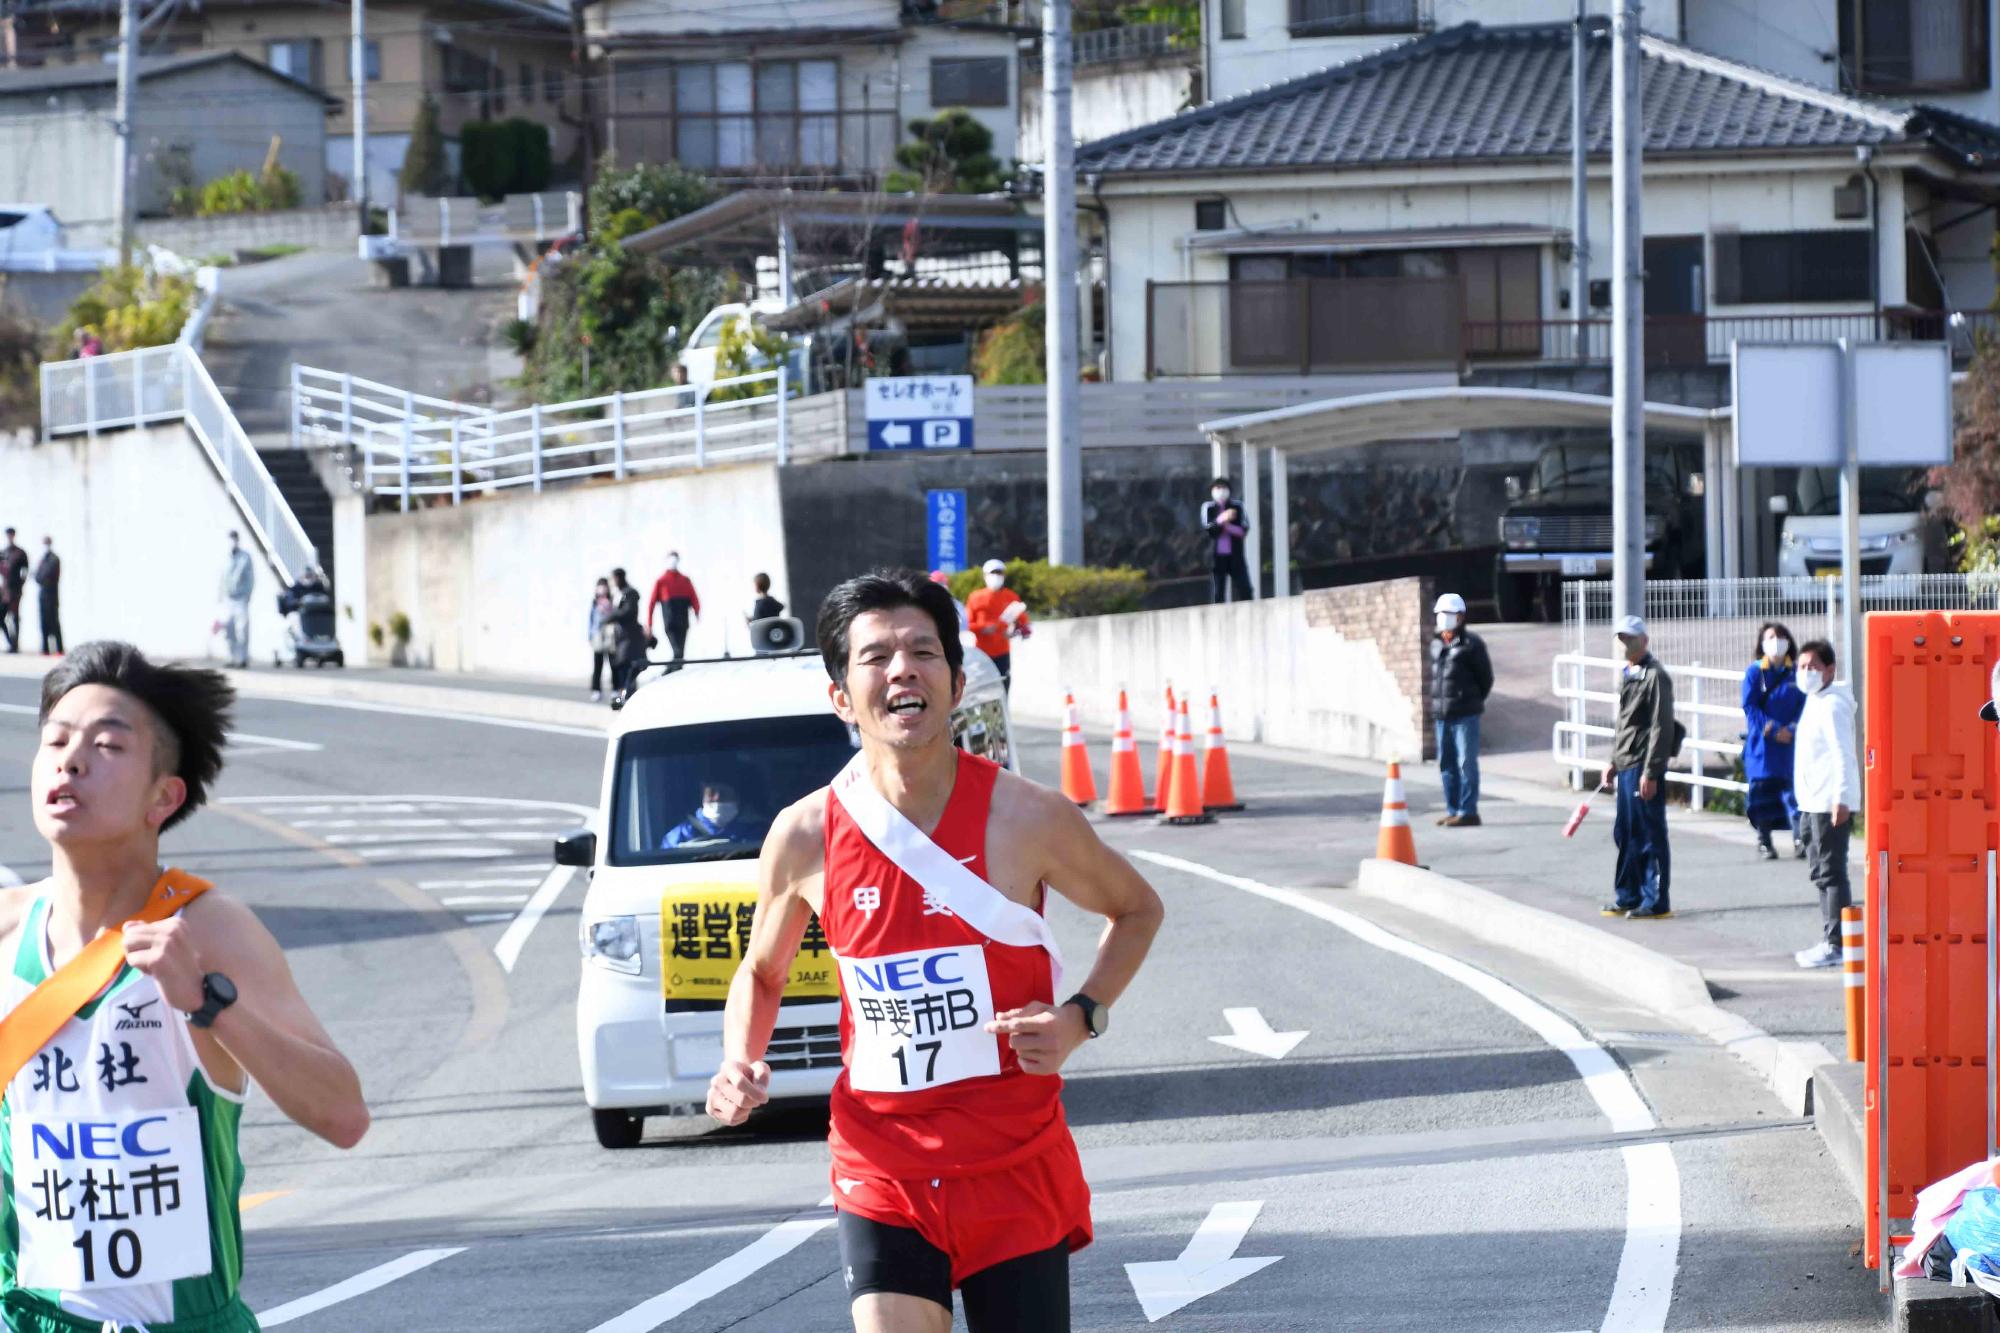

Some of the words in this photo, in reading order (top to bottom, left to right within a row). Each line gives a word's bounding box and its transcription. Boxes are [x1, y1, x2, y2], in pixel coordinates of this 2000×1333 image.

[934, 425, 951, 443] P
[796, 970, 830, 982] JAAF
[854, 952, 964, 993] NEC
[859, 988, 979, 1039] 甲斐市B
[33, 1041, 148, 1093] 北杜
[891, 1040, 943, 1086] 17
[31, 1116, 172, 1161] NEC
[32, 1163, 181, 1222] 北杜市
[72, 1228, 143, 1283] 10
